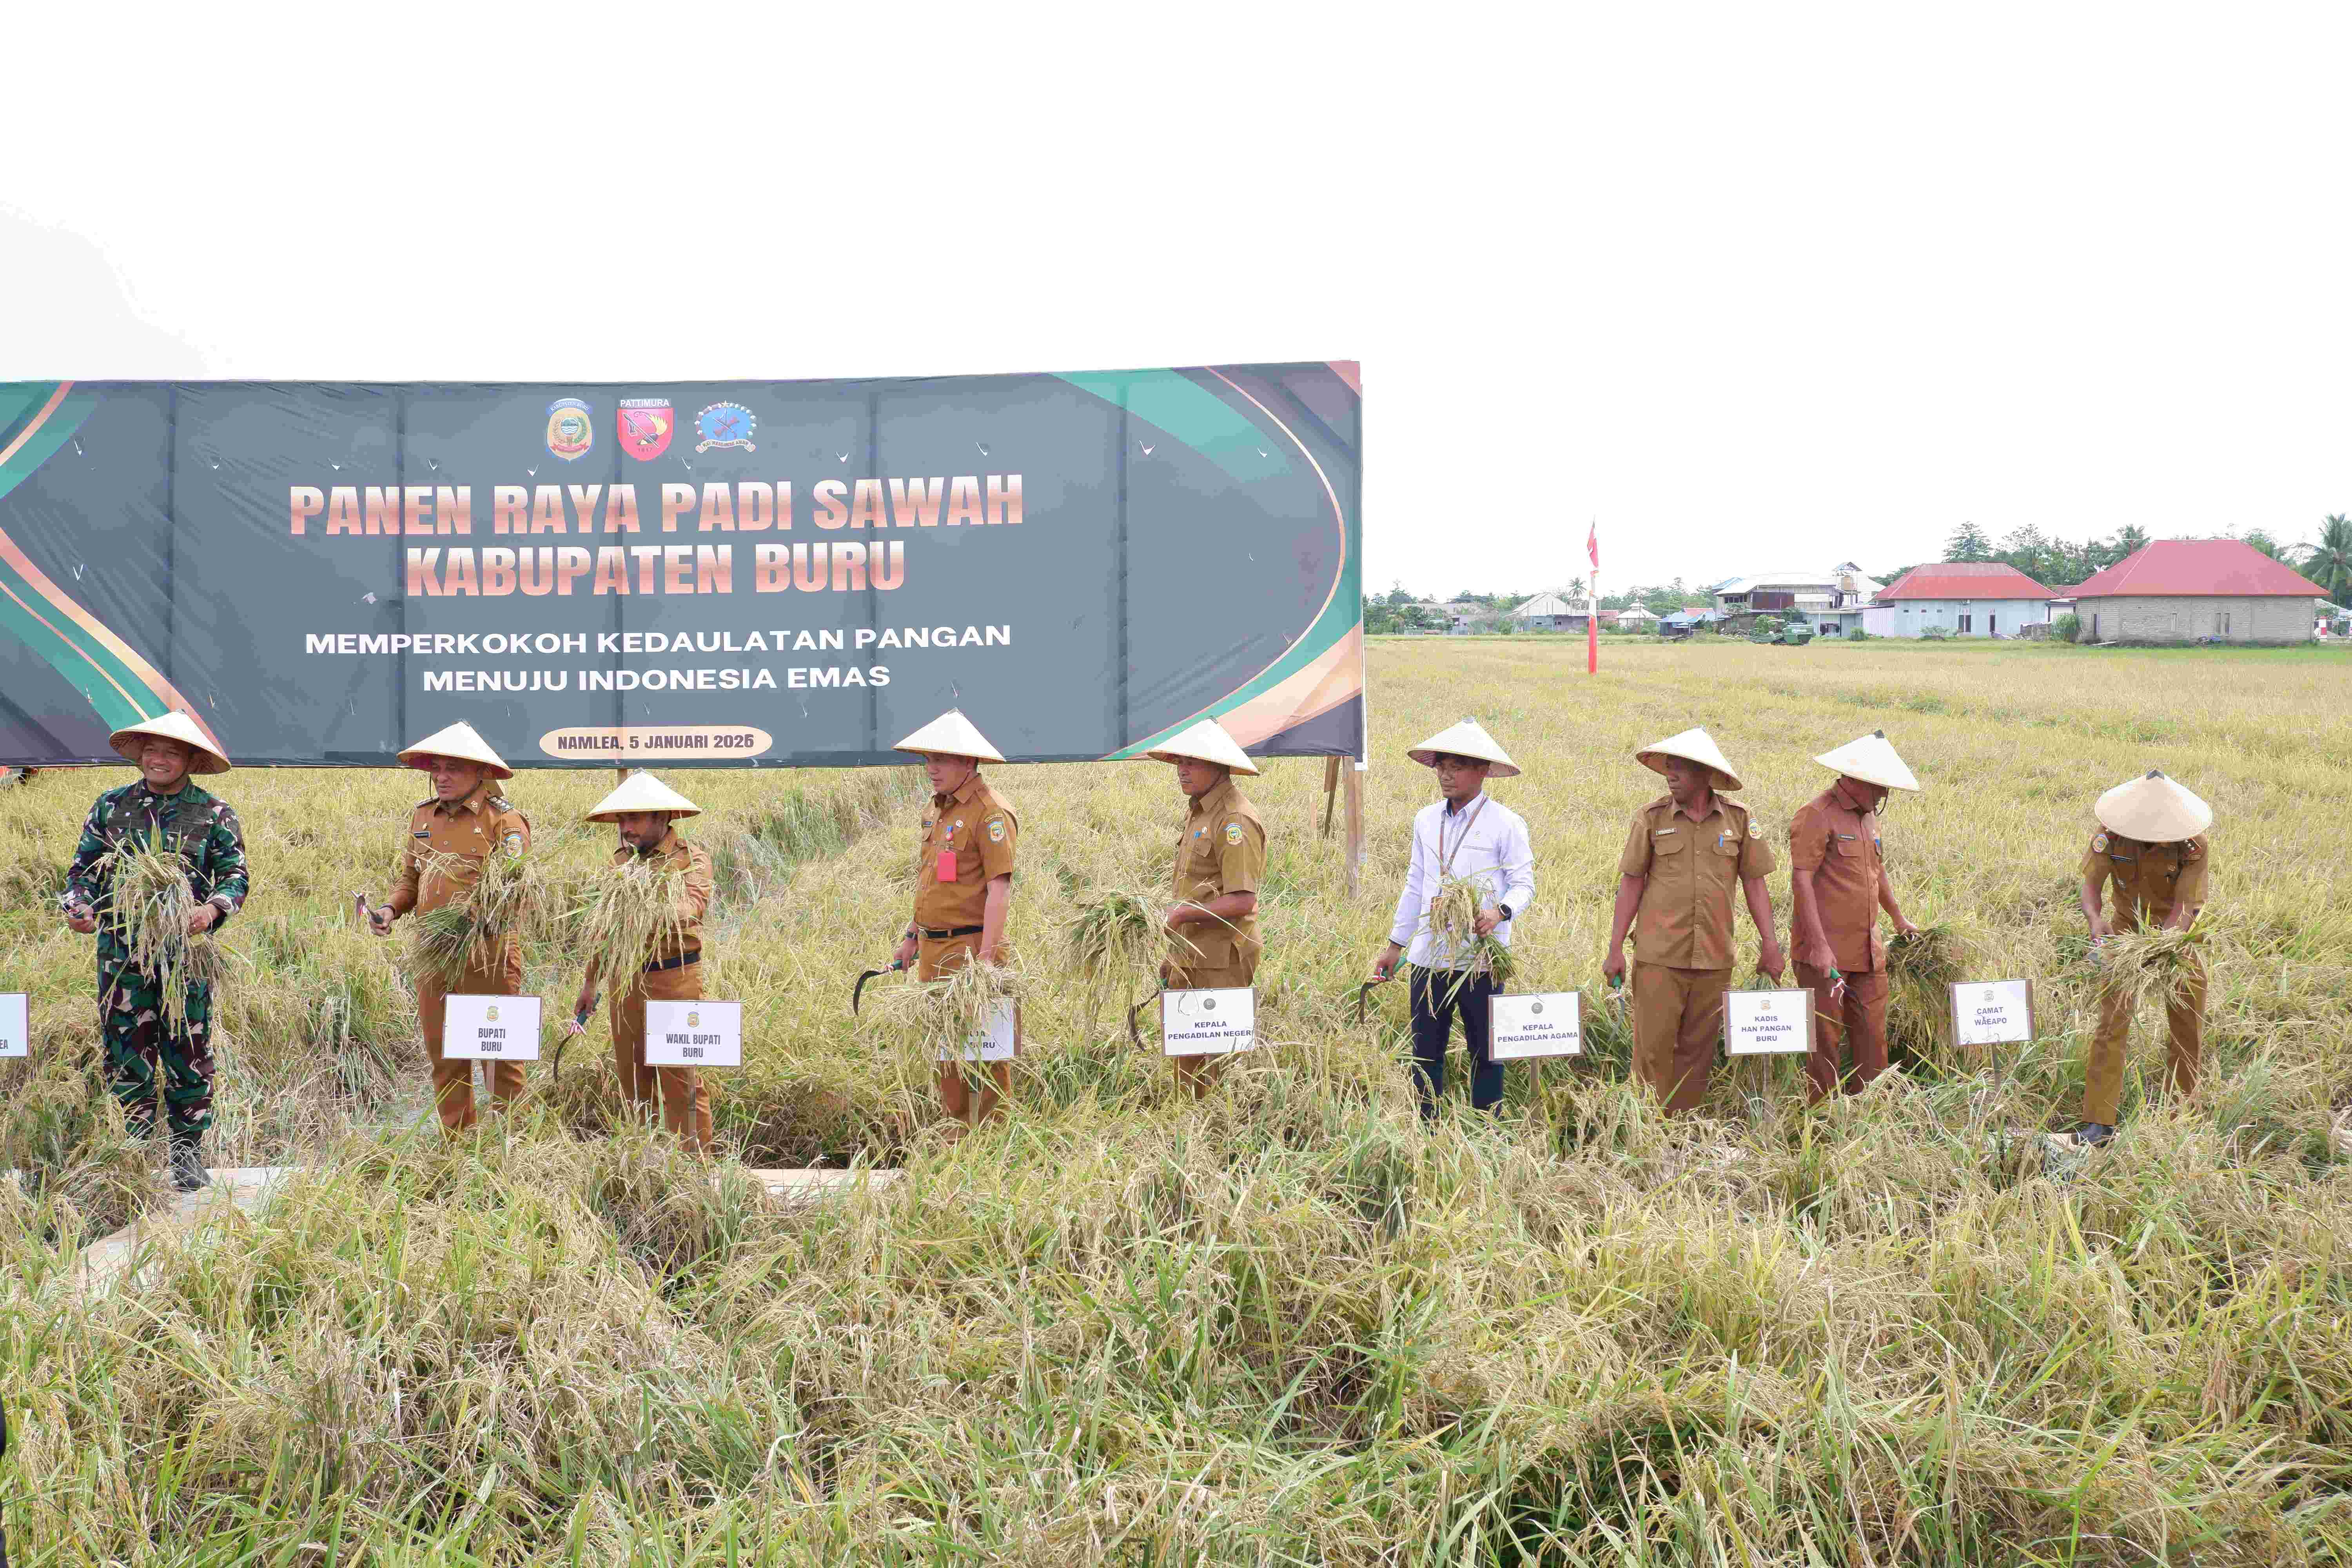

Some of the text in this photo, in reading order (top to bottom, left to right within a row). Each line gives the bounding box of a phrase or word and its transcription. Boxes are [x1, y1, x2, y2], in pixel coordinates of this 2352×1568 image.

[290, 474, 1023, 534] PANEN RAYA PADI SAWAH
[407, 540, 904, 596] KABUPATEN BURU
[305, 625, 1011, 654] MEMPERKOKOH KEDAULATAN PANGAN
[423, 666, 891, 691] MENUJU INDONESIA EMAS
[558, 734, 754, 750] NAMLEA, 5 JANUARI 2026
[1974, 1018, 2007, 1026] WAEAPO
[478, 1027, 506, 1039] BUPATI
[666, 1033, 720, 1045] WAKIL BUPATI
[1168, 1031, 1221, 1040] PENGADILAN
[1497, 1034, 1548, 1043] PENGADILAN
[481, 1041, 502, 1051] BURU
[683, 1047, 703, 1058] BURU
